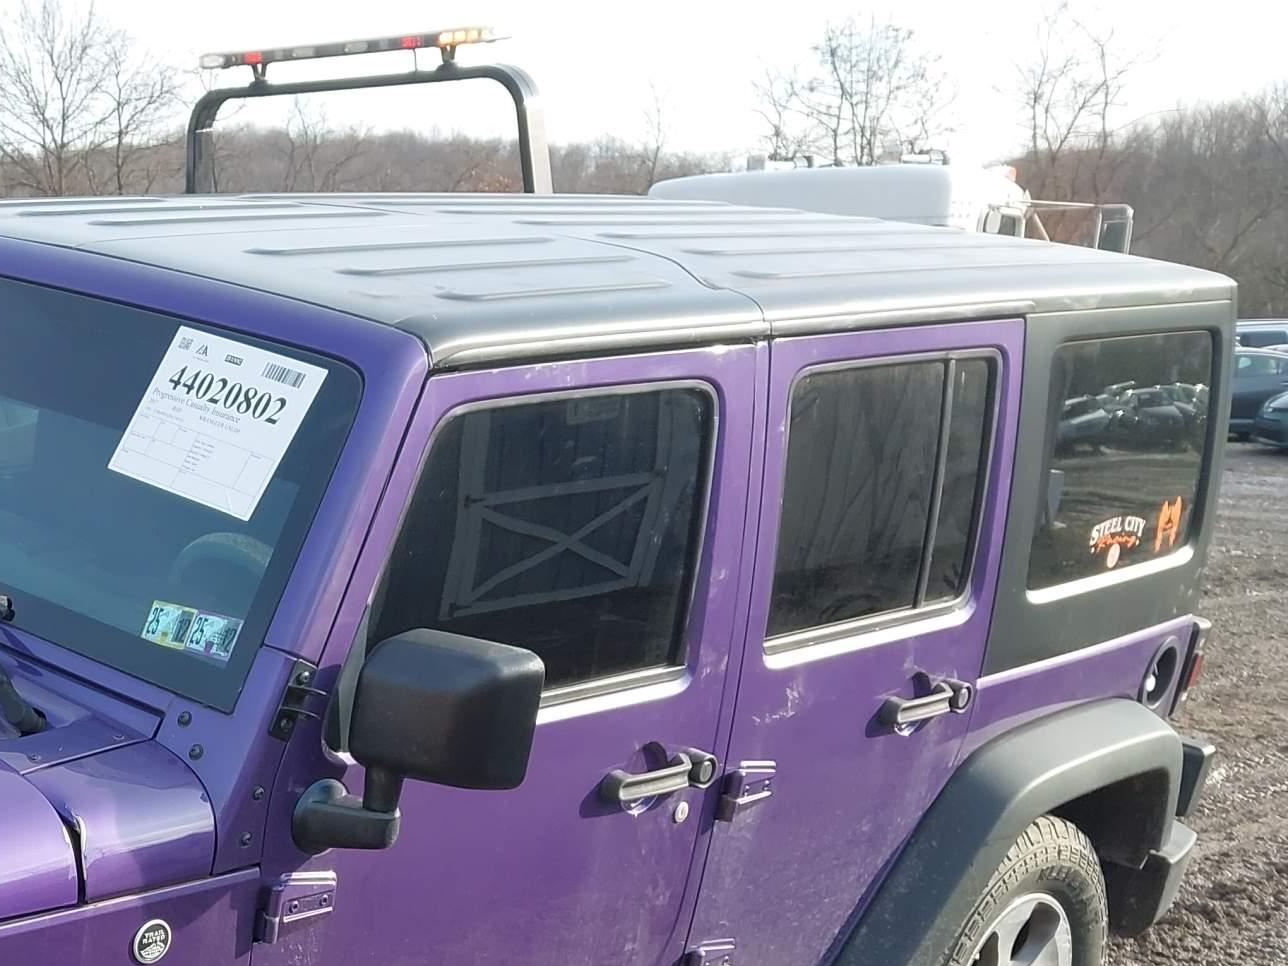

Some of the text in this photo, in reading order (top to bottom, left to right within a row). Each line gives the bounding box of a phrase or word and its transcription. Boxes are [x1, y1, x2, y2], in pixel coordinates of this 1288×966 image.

[168, 365, 287, 423] 44020802
[1090, 516, 1146, 546] STEEL CITY
[147, 607, 164, 635] 25
[190, 616, 208, 645] 25
[142, 934, 165, 944] RATED
